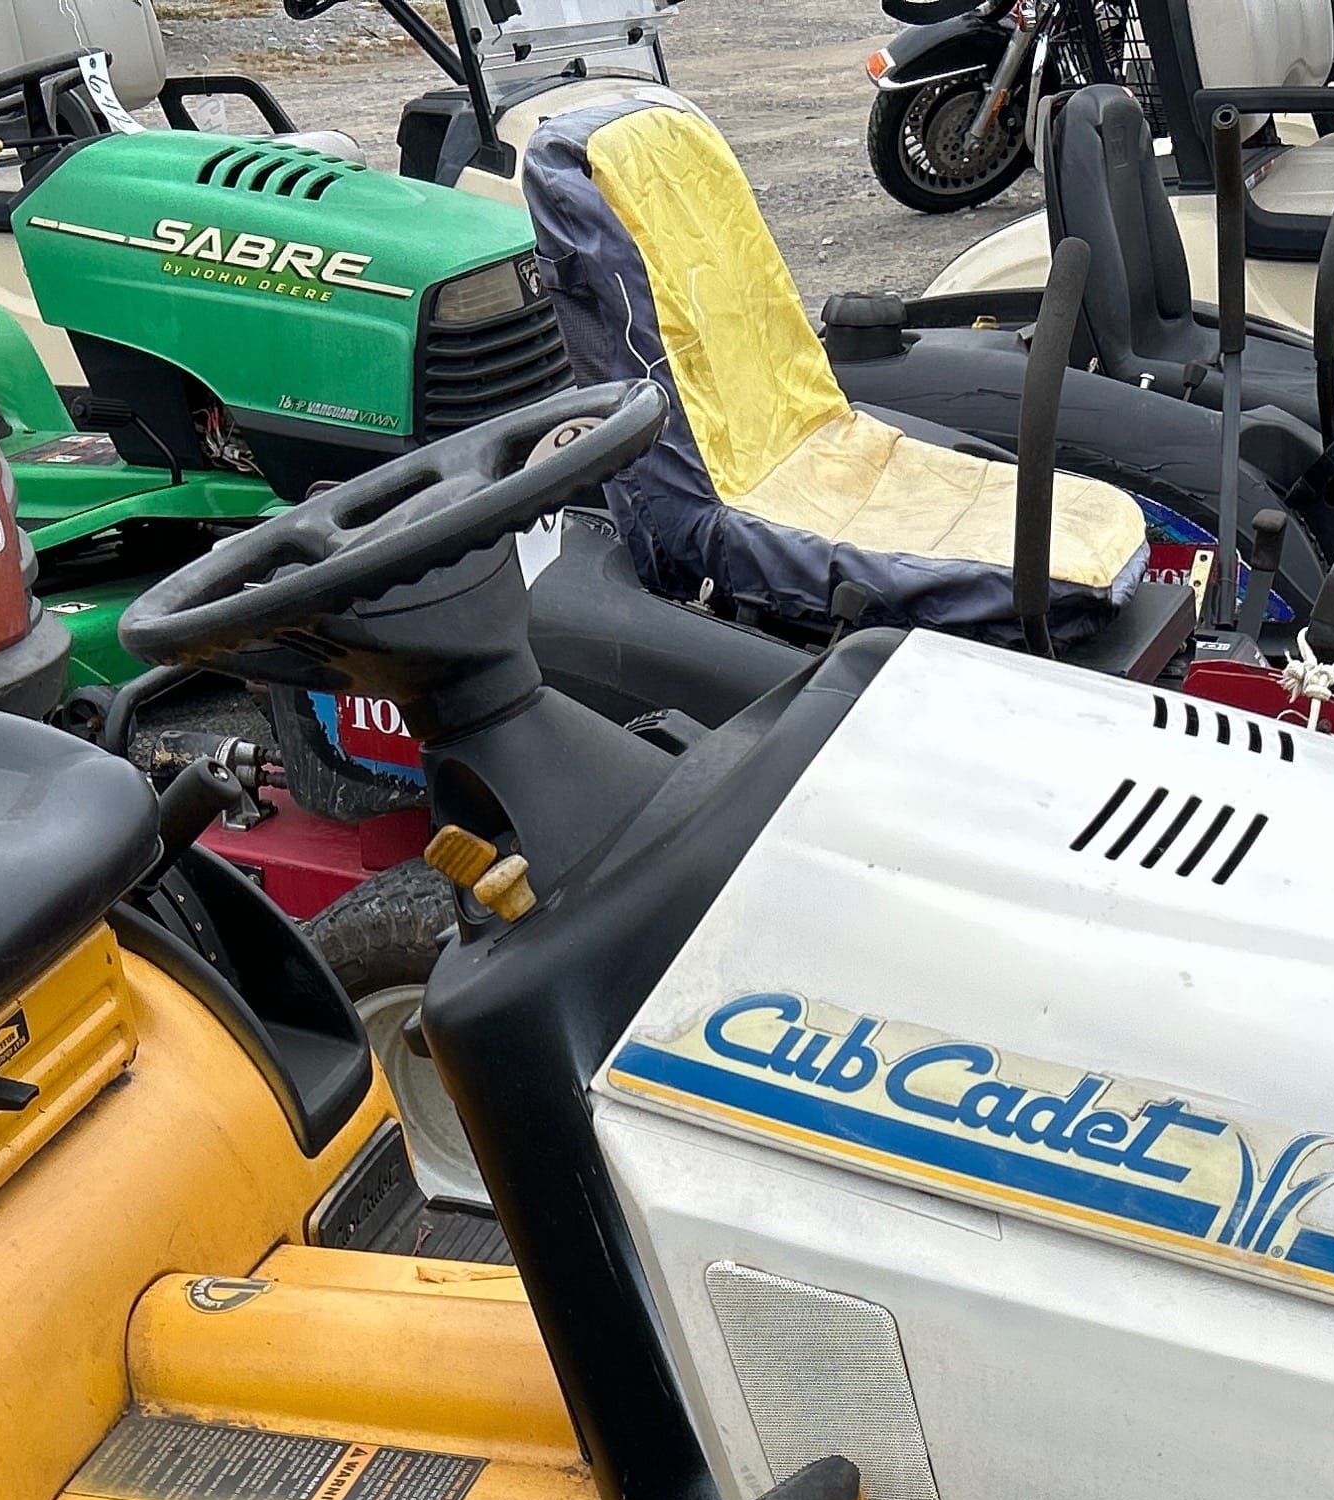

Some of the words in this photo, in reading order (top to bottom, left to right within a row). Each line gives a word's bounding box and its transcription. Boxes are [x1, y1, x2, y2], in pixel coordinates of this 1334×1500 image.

[155, 217, 373, 284] SABRE
[163, 261, 182, 276] by
[190, 266, 247, 286] JOHN
[258, 279, 333, 302] DEERE
[345, 695, 412, 738] TO
[704, 992, 879, 1094] Cub
[885, 1043, 1230, 1184] Cadet
